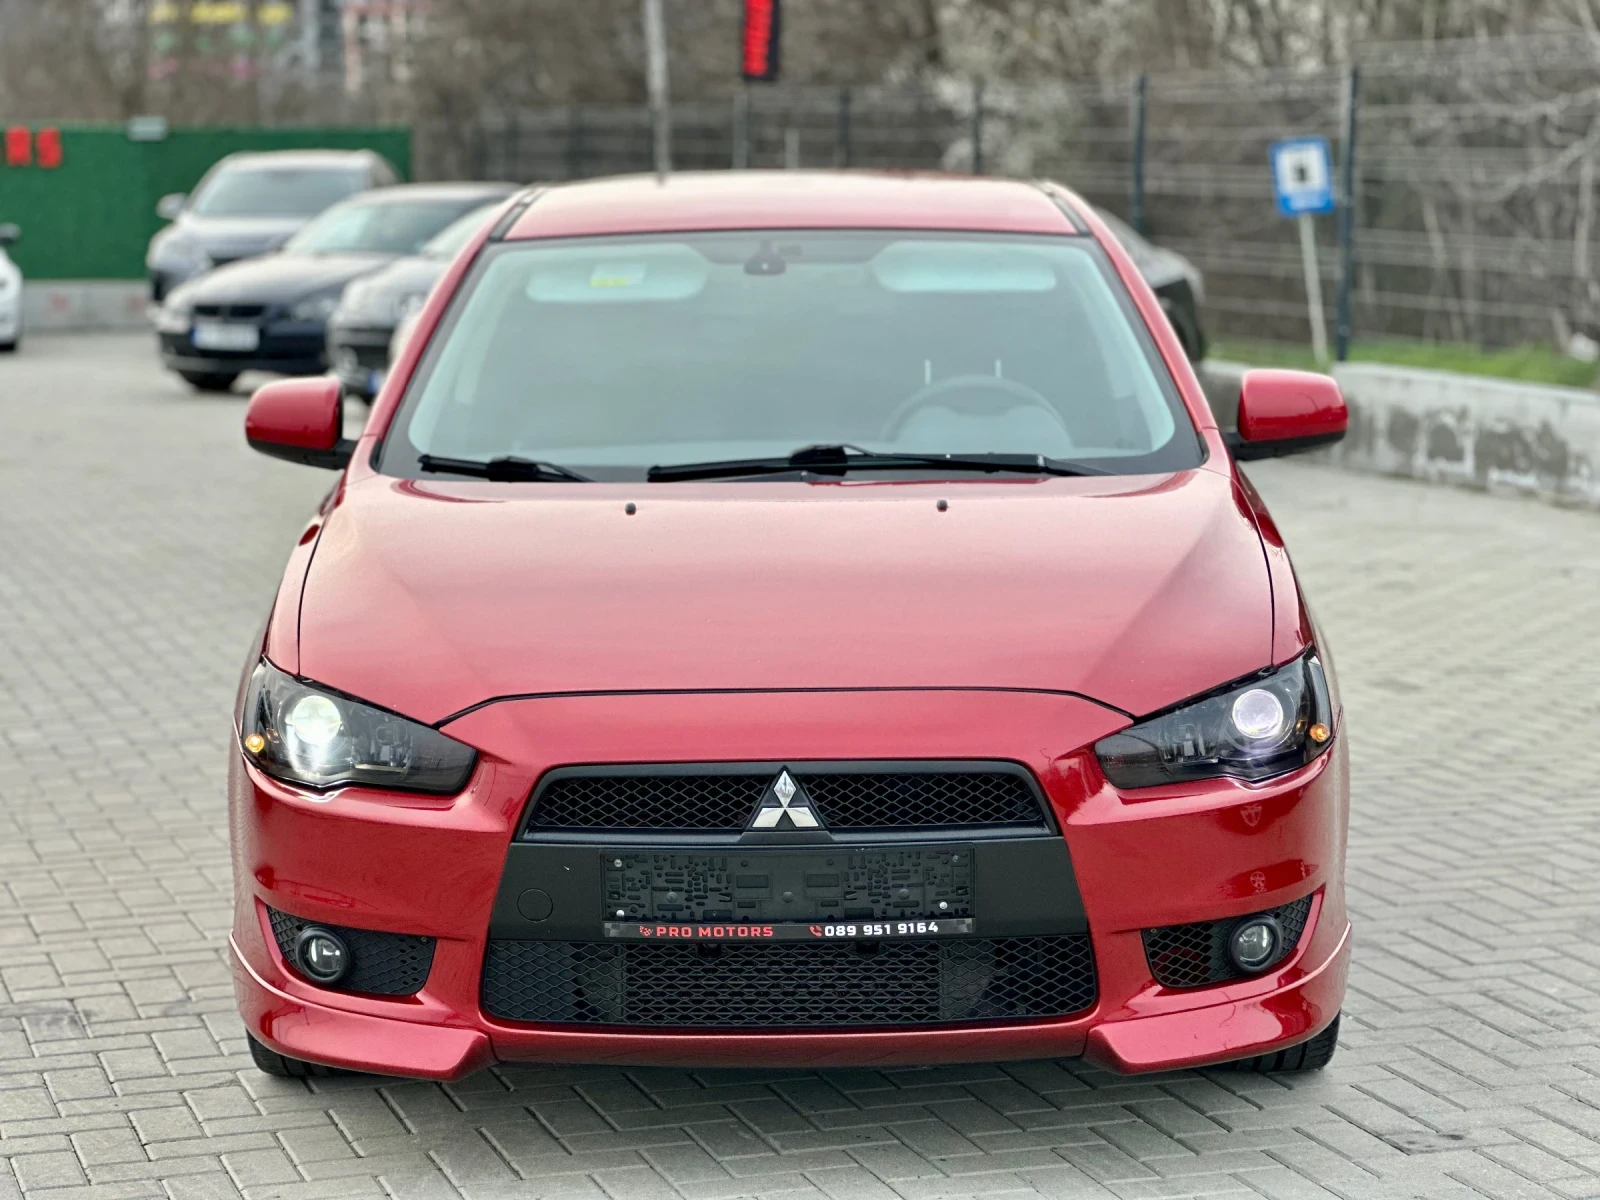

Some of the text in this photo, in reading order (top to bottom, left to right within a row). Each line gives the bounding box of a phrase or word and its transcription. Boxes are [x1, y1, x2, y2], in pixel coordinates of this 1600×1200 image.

[655, 926, 774, 938] PRO MOTORS
[824, 921, 939, 937] 089 951 9164
